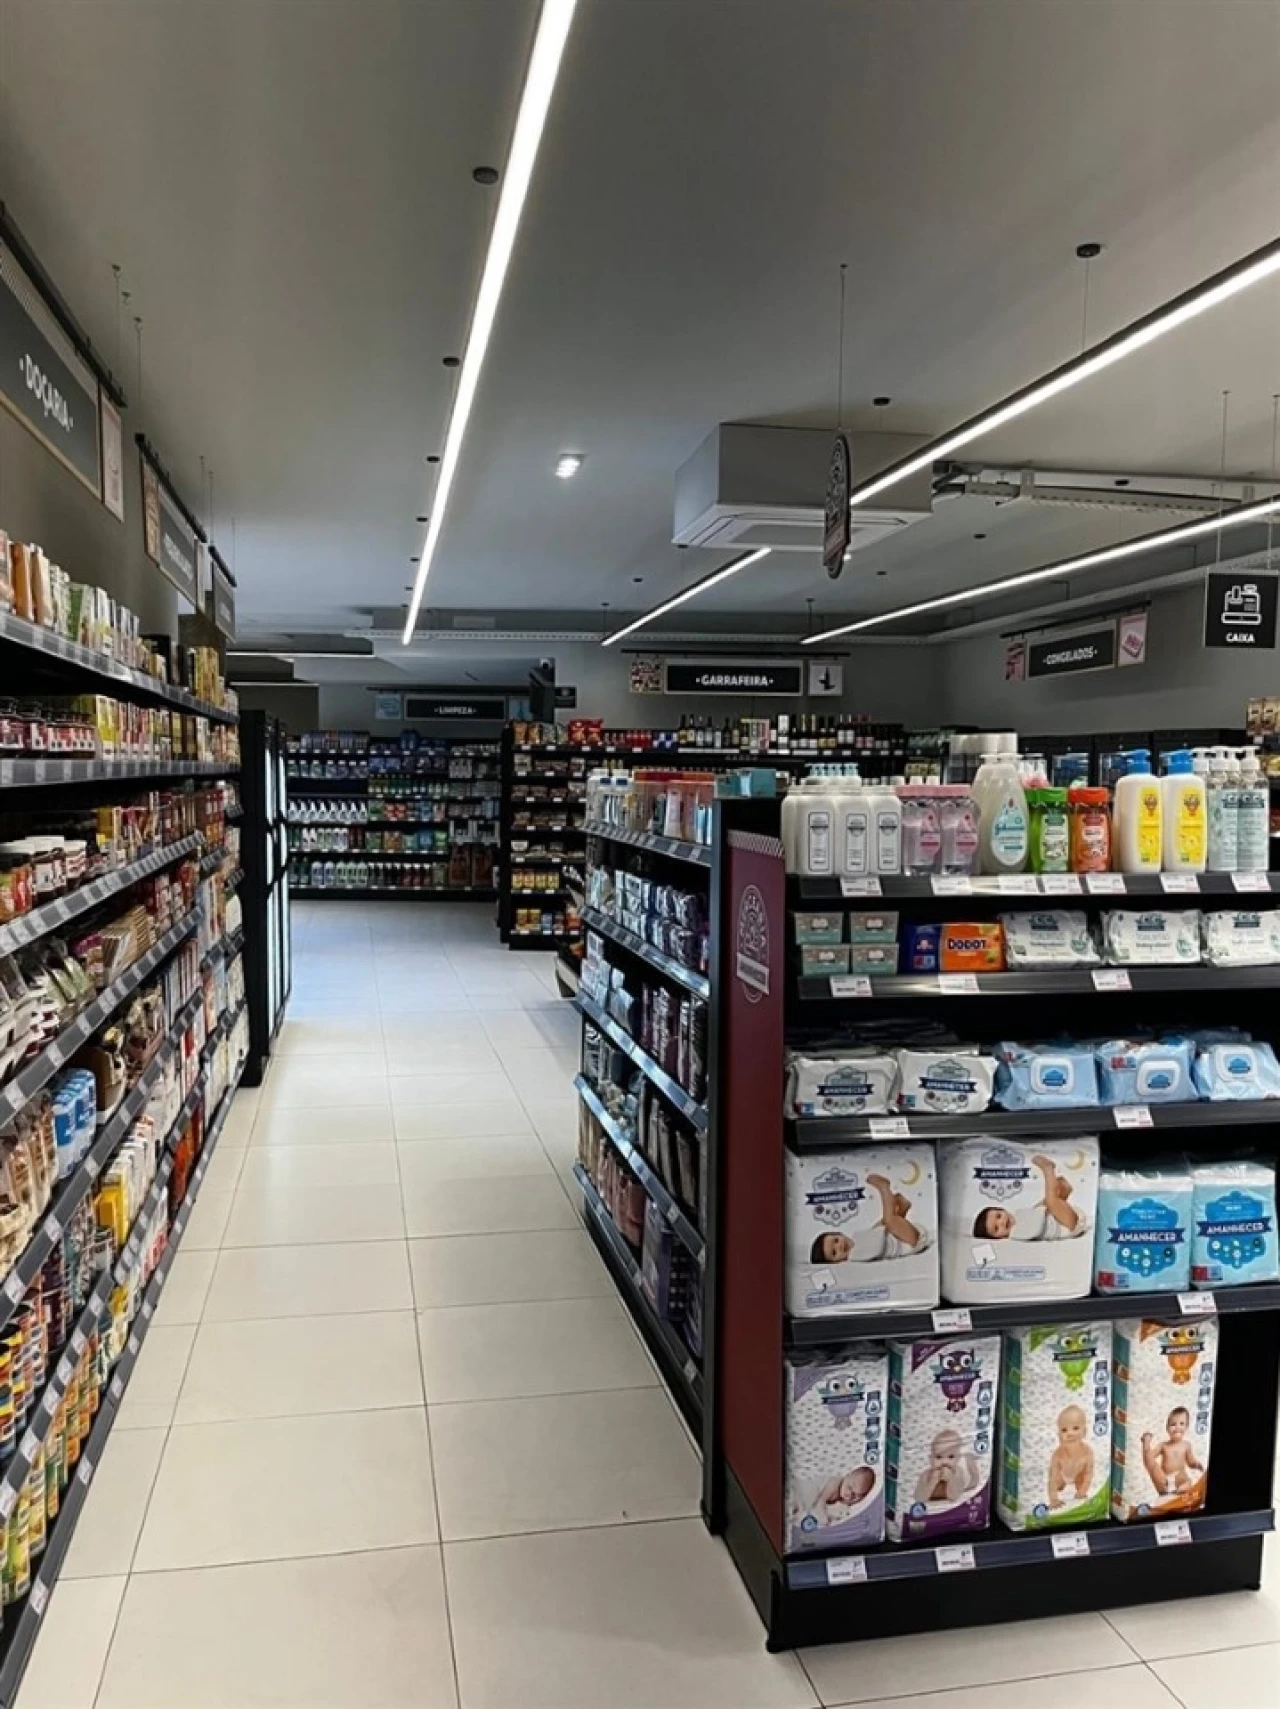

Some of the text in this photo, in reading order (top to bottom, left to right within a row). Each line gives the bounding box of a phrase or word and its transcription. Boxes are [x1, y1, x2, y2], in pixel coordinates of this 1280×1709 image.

[1226, 633, 1255, 643] CAIXA
[1046, 646, 1094, 665] CONGELADOS
[701, 674, 768, 686] GARRAFEIRA
[439, 706, 473, 715] LIMPEZA
[948, 938, 986, 950] DODOT
[1207, 1222, 1264, 1235] AMANHECER
[1117, 1231, 1176, 1242] AMANHECER
